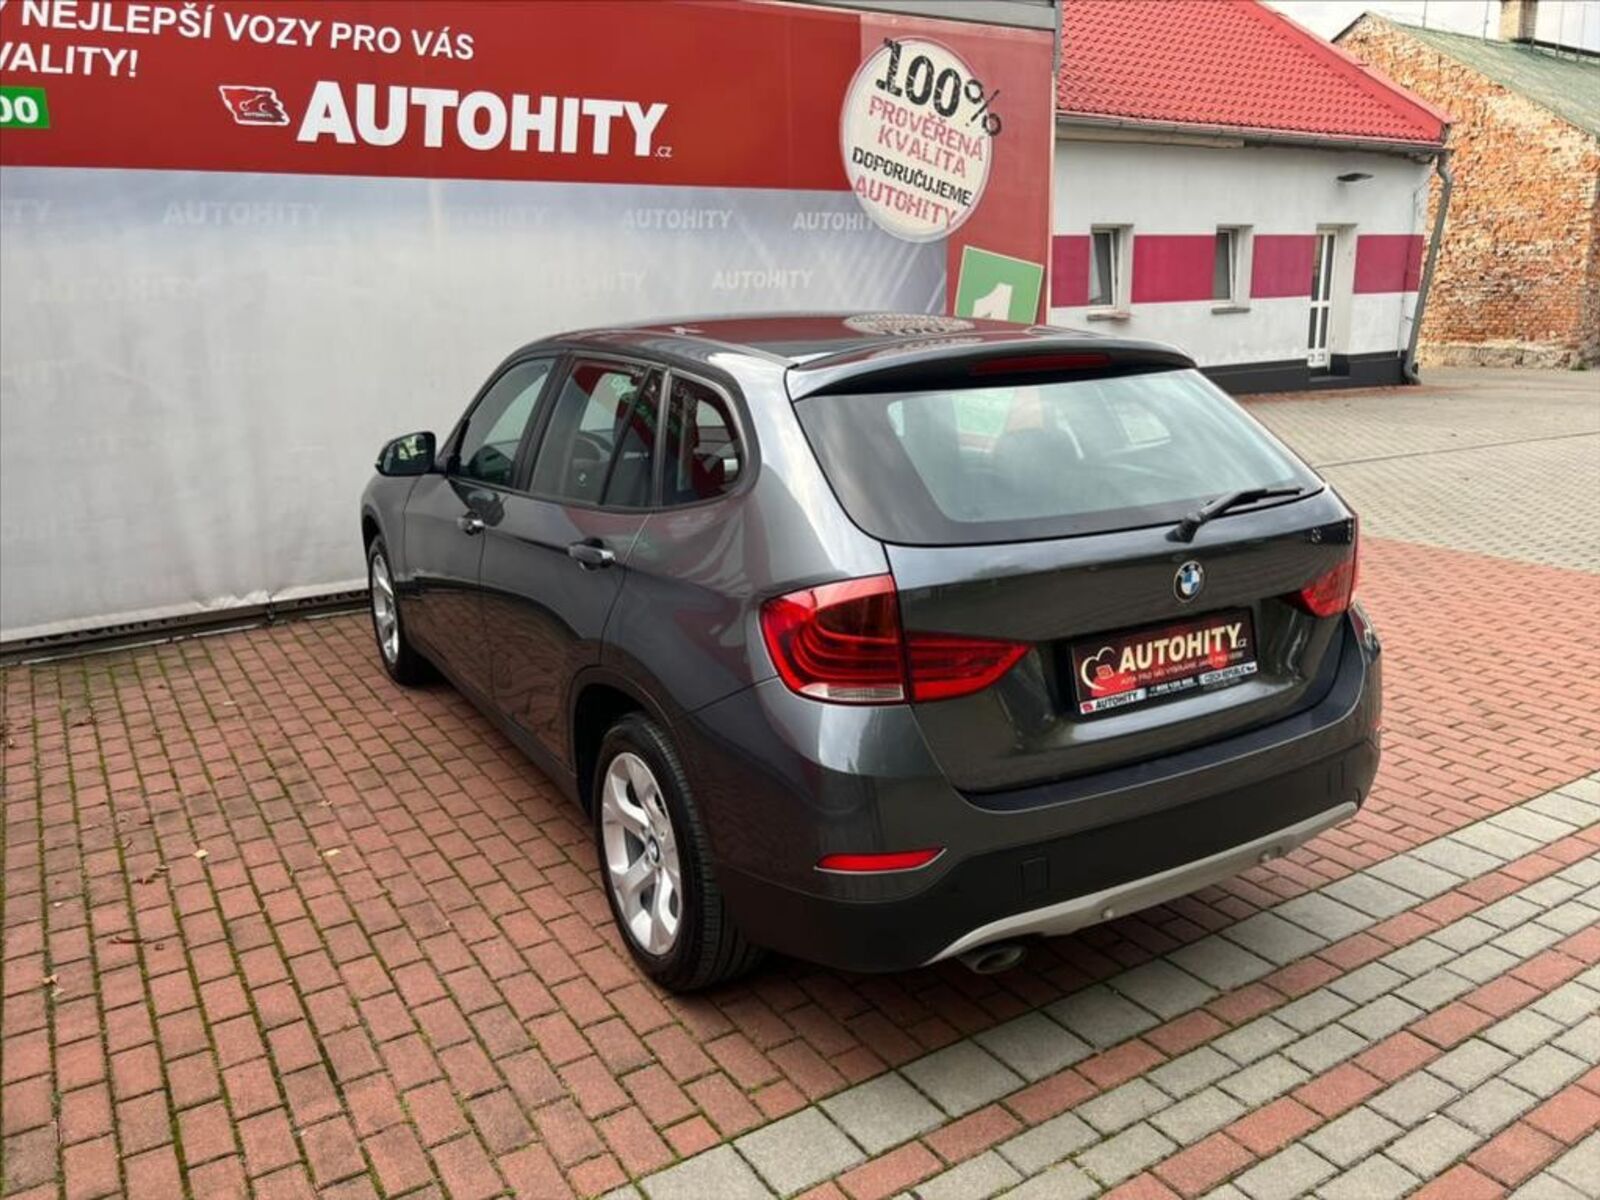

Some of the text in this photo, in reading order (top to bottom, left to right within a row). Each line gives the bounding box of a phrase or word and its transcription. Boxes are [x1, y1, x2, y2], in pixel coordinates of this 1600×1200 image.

[22, 0, 475, 60] NEJLEPŠÍ VOZY PRO VÁS
[876, 38, 1002, 136] 100%
[296, 81, 669, 157] AUTOHITY
[868, 96, 985, 161] PROVĚŘENÁ
[852, 147, 972, 208] DOPORUČUJEME
[878, 124, 967, 178] KVALITA
[163, 199, 322, 226] AUTOHITY
[623, 208, 733, 231] AUTOHITY
[855, 175, 957, 230] AUTOHITY
[712, 269, 813, 291] AUTOHITY
[1118, 622, 1242, 674] AUTOHITY
